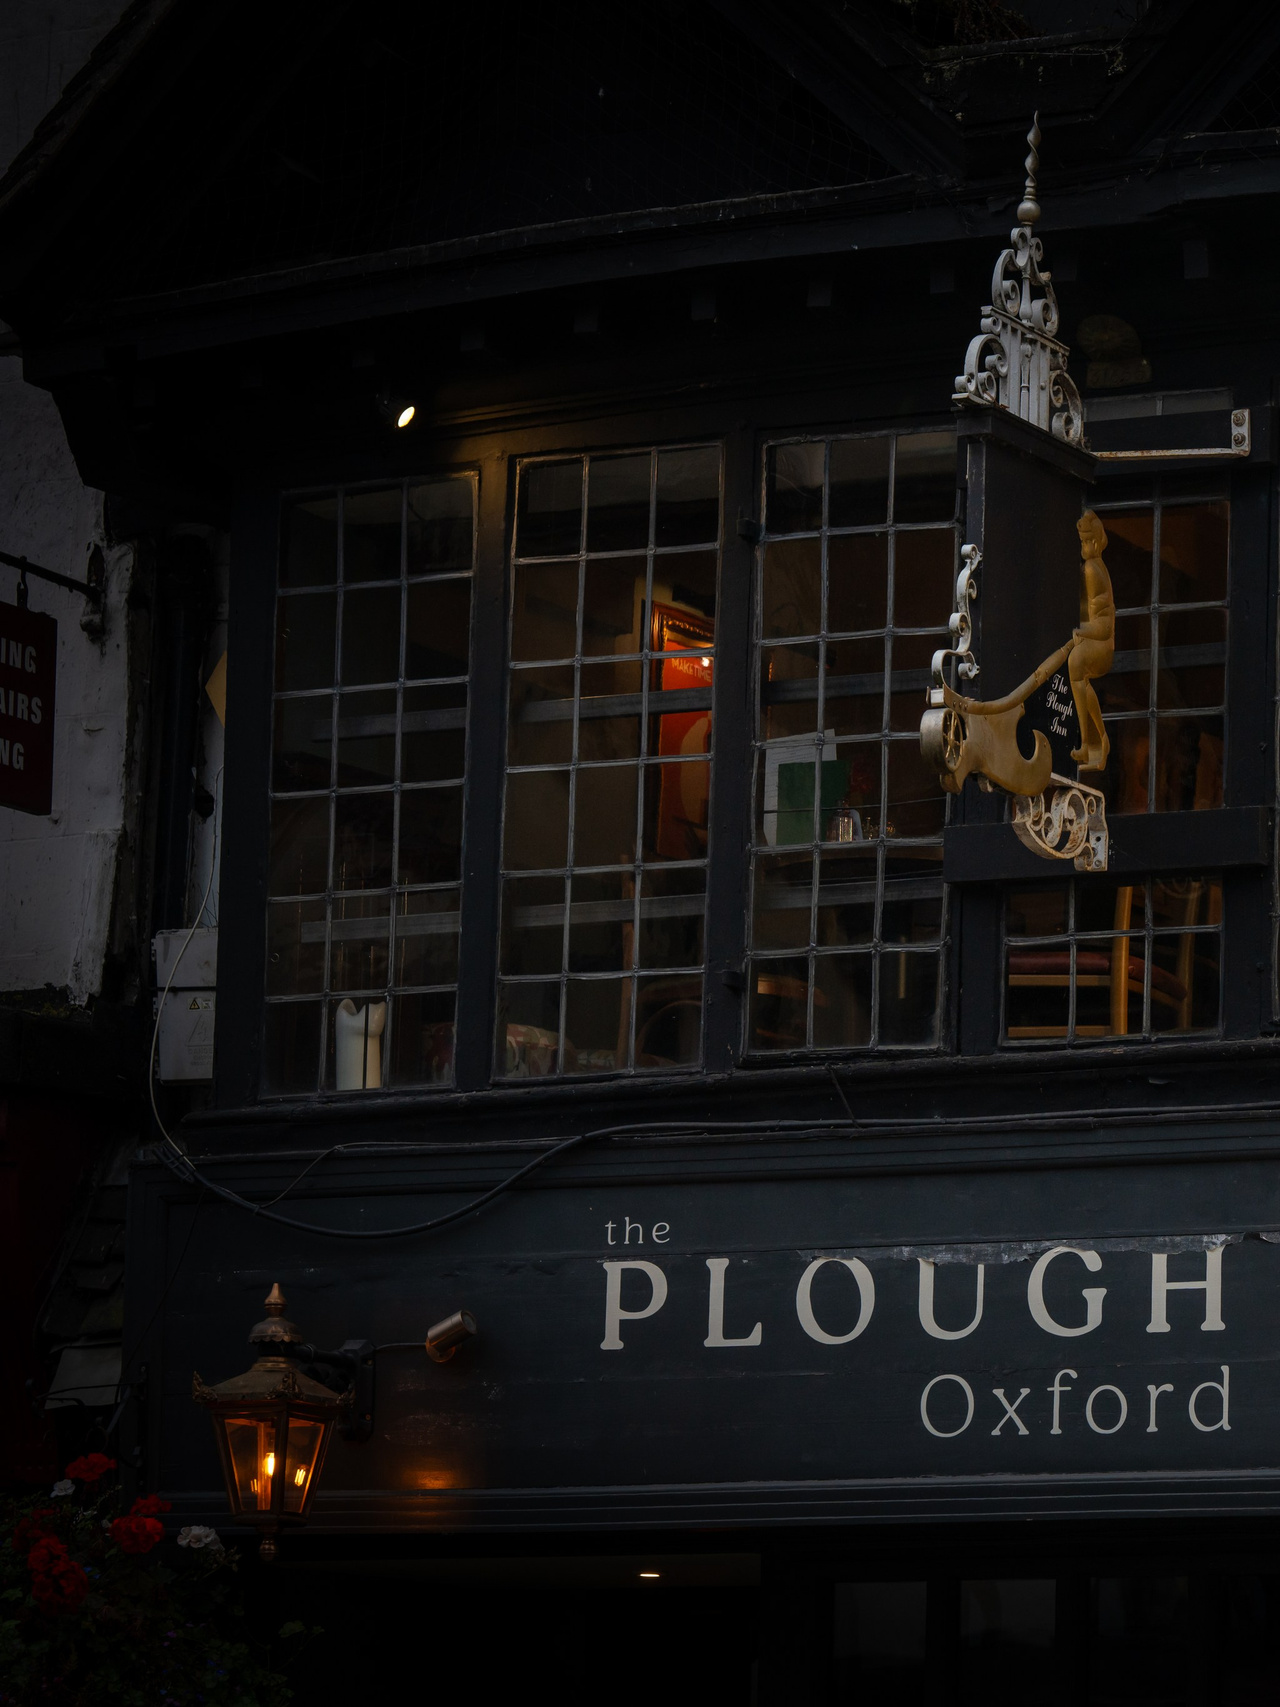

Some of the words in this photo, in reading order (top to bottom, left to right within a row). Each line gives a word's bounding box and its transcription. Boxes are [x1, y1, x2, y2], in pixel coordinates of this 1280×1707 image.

[672, 658, 694, 675] MAKE
[1052, 674, 1068, 694] The
[1046, 692, 1073, 721] Plough
[1051, 716, 1068, 737] Inn
[604, 1216, 671, 1246] the
[601, 1243, 1227, 1351] PLOUGH
[920, 1365, 1232, 1438] Oxford
